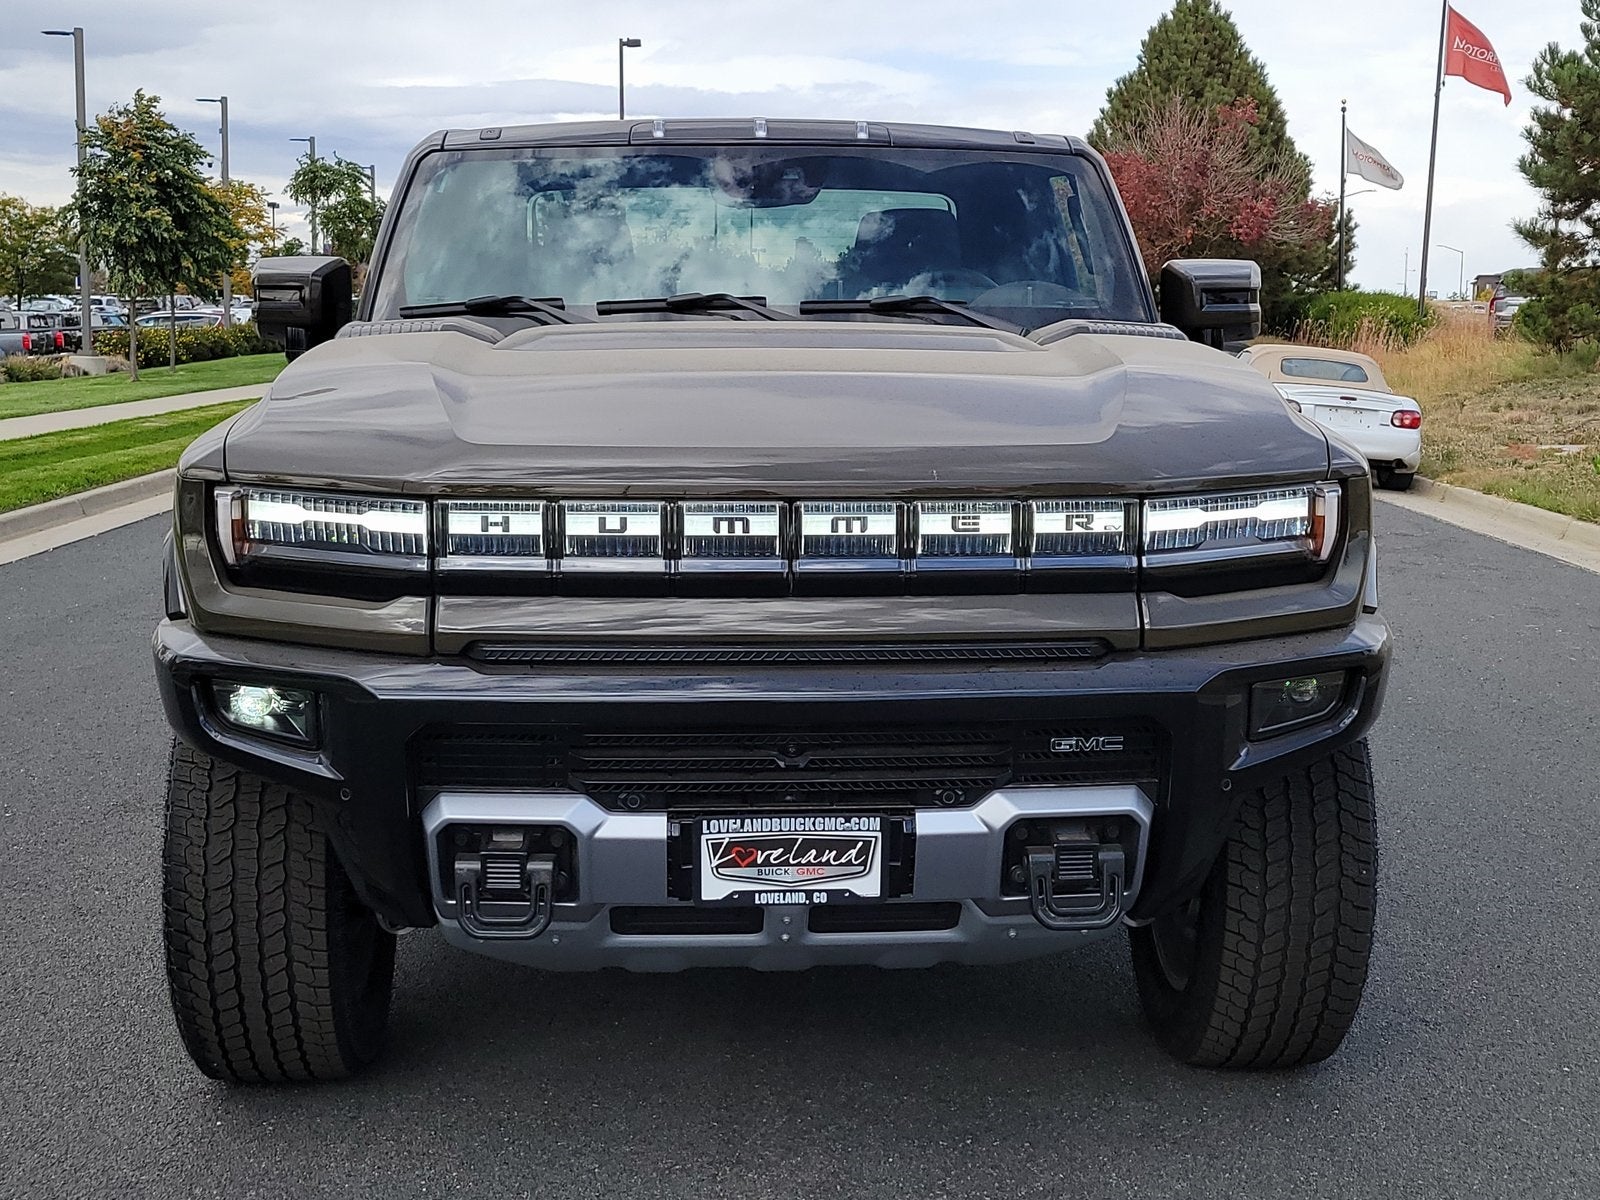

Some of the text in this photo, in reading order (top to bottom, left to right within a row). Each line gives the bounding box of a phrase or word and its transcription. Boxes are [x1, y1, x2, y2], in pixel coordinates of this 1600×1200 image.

[1050, 736, 1124, 752] GMC
[702, 817, 881, 834] LOVELANDBUICKGMCCOM
[757, 867, 825, 876] BUICK GMC
[754, 891, 828, 904] LOVELAND, CO
